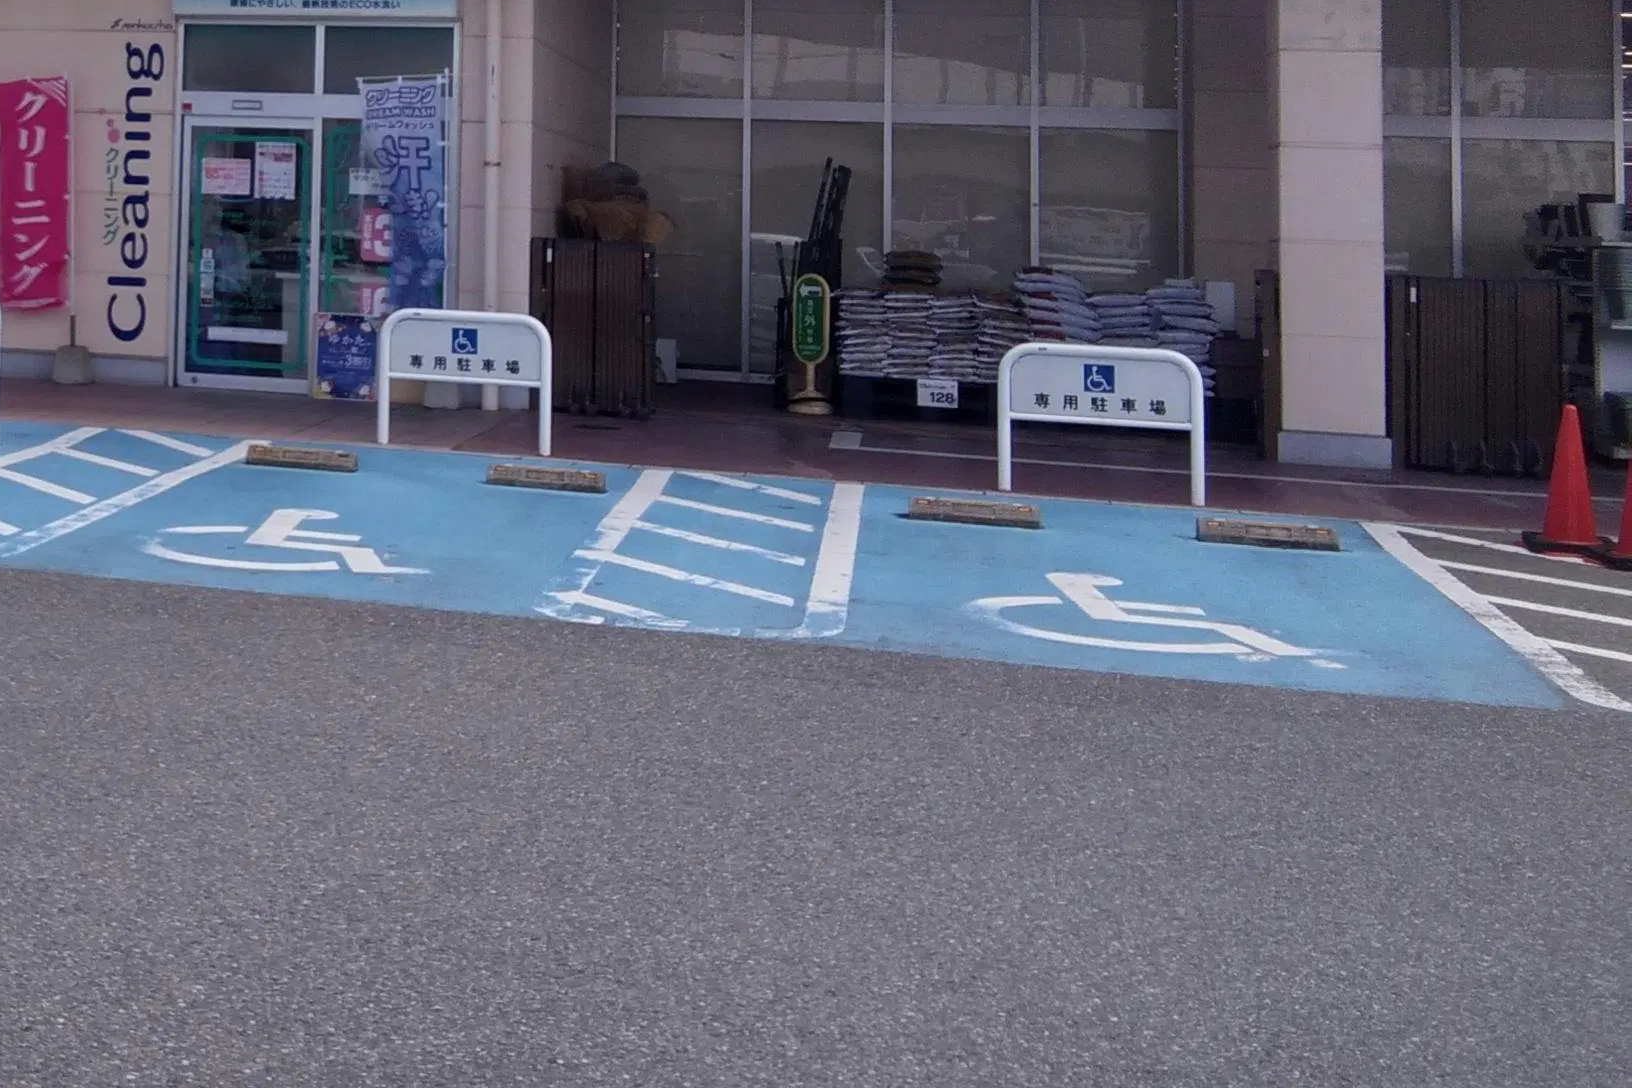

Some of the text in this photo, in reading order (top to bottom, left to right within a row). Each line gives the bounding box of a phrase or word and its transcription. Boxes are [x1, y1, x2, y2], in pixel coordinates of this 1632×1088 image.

[366, 85, 436, 106] クリーニング
[403, 107, 436, 118] WASH
[11, 91, 51, 295] クリーニング
[103, 147, 120, 246] クリーニング
[107, 42, 165, 341] Cleaning
[409, 354, 520, 374] 専用駐車場
[930, 391, 955, 404] 128
[1034, 392, 1167, 416] 専用駐車場
